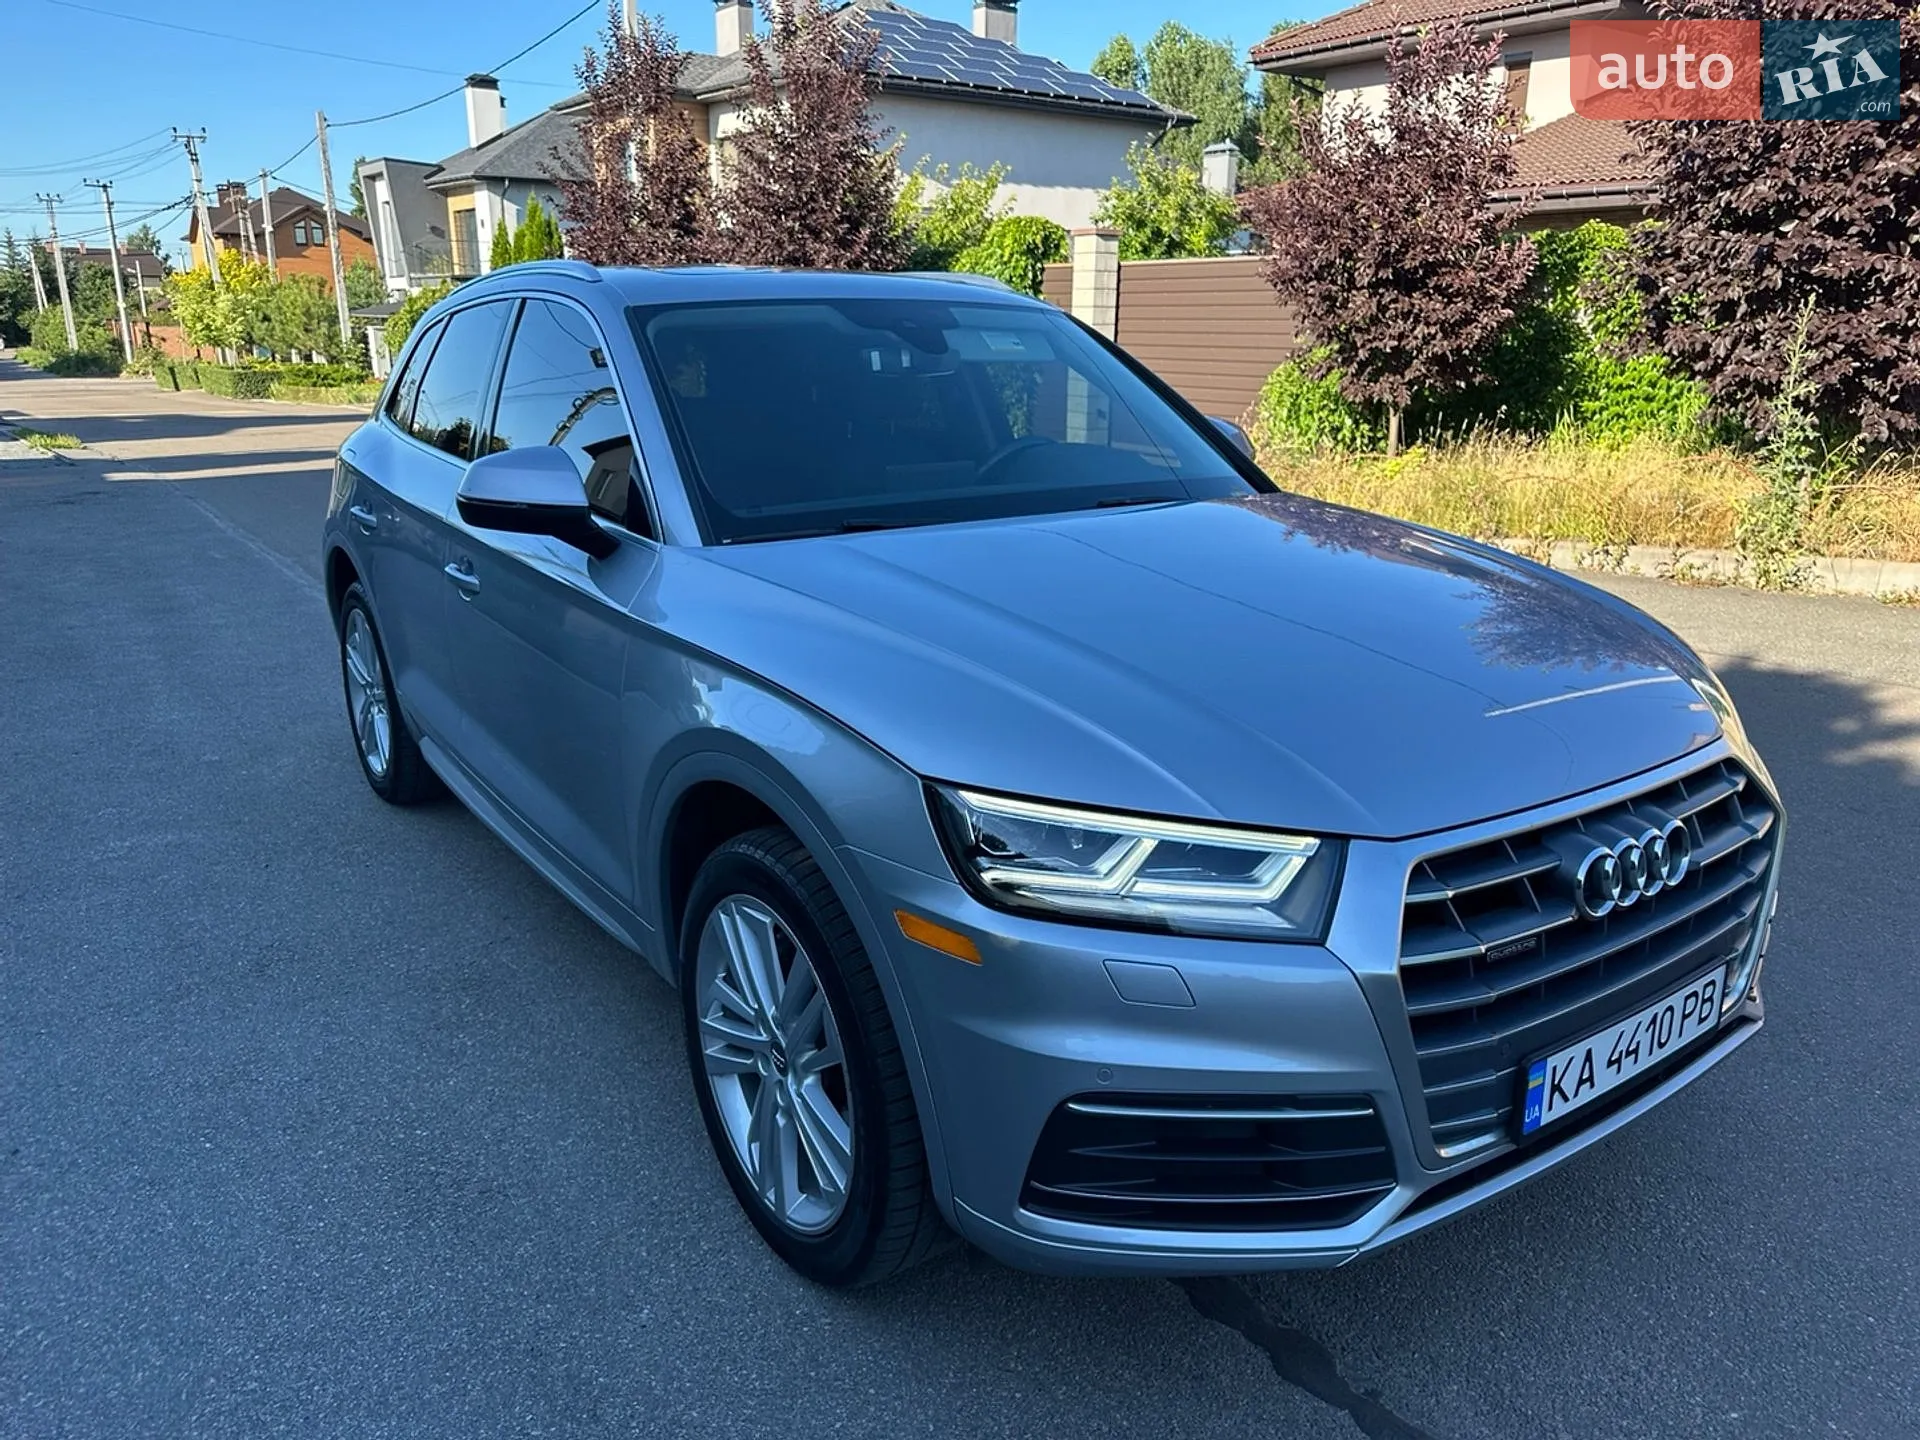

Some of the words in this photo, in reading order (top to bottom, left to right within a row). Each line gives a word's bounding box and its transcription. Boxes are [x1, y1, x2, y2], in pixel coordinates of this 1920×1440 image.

[1547, 1047, 1595, 1112] KA
[1606, 1004, 1675, 1075] 4410
[1678, 979, 1717, 1038] PB
[1525, 1104, 1539, 1122] UA
